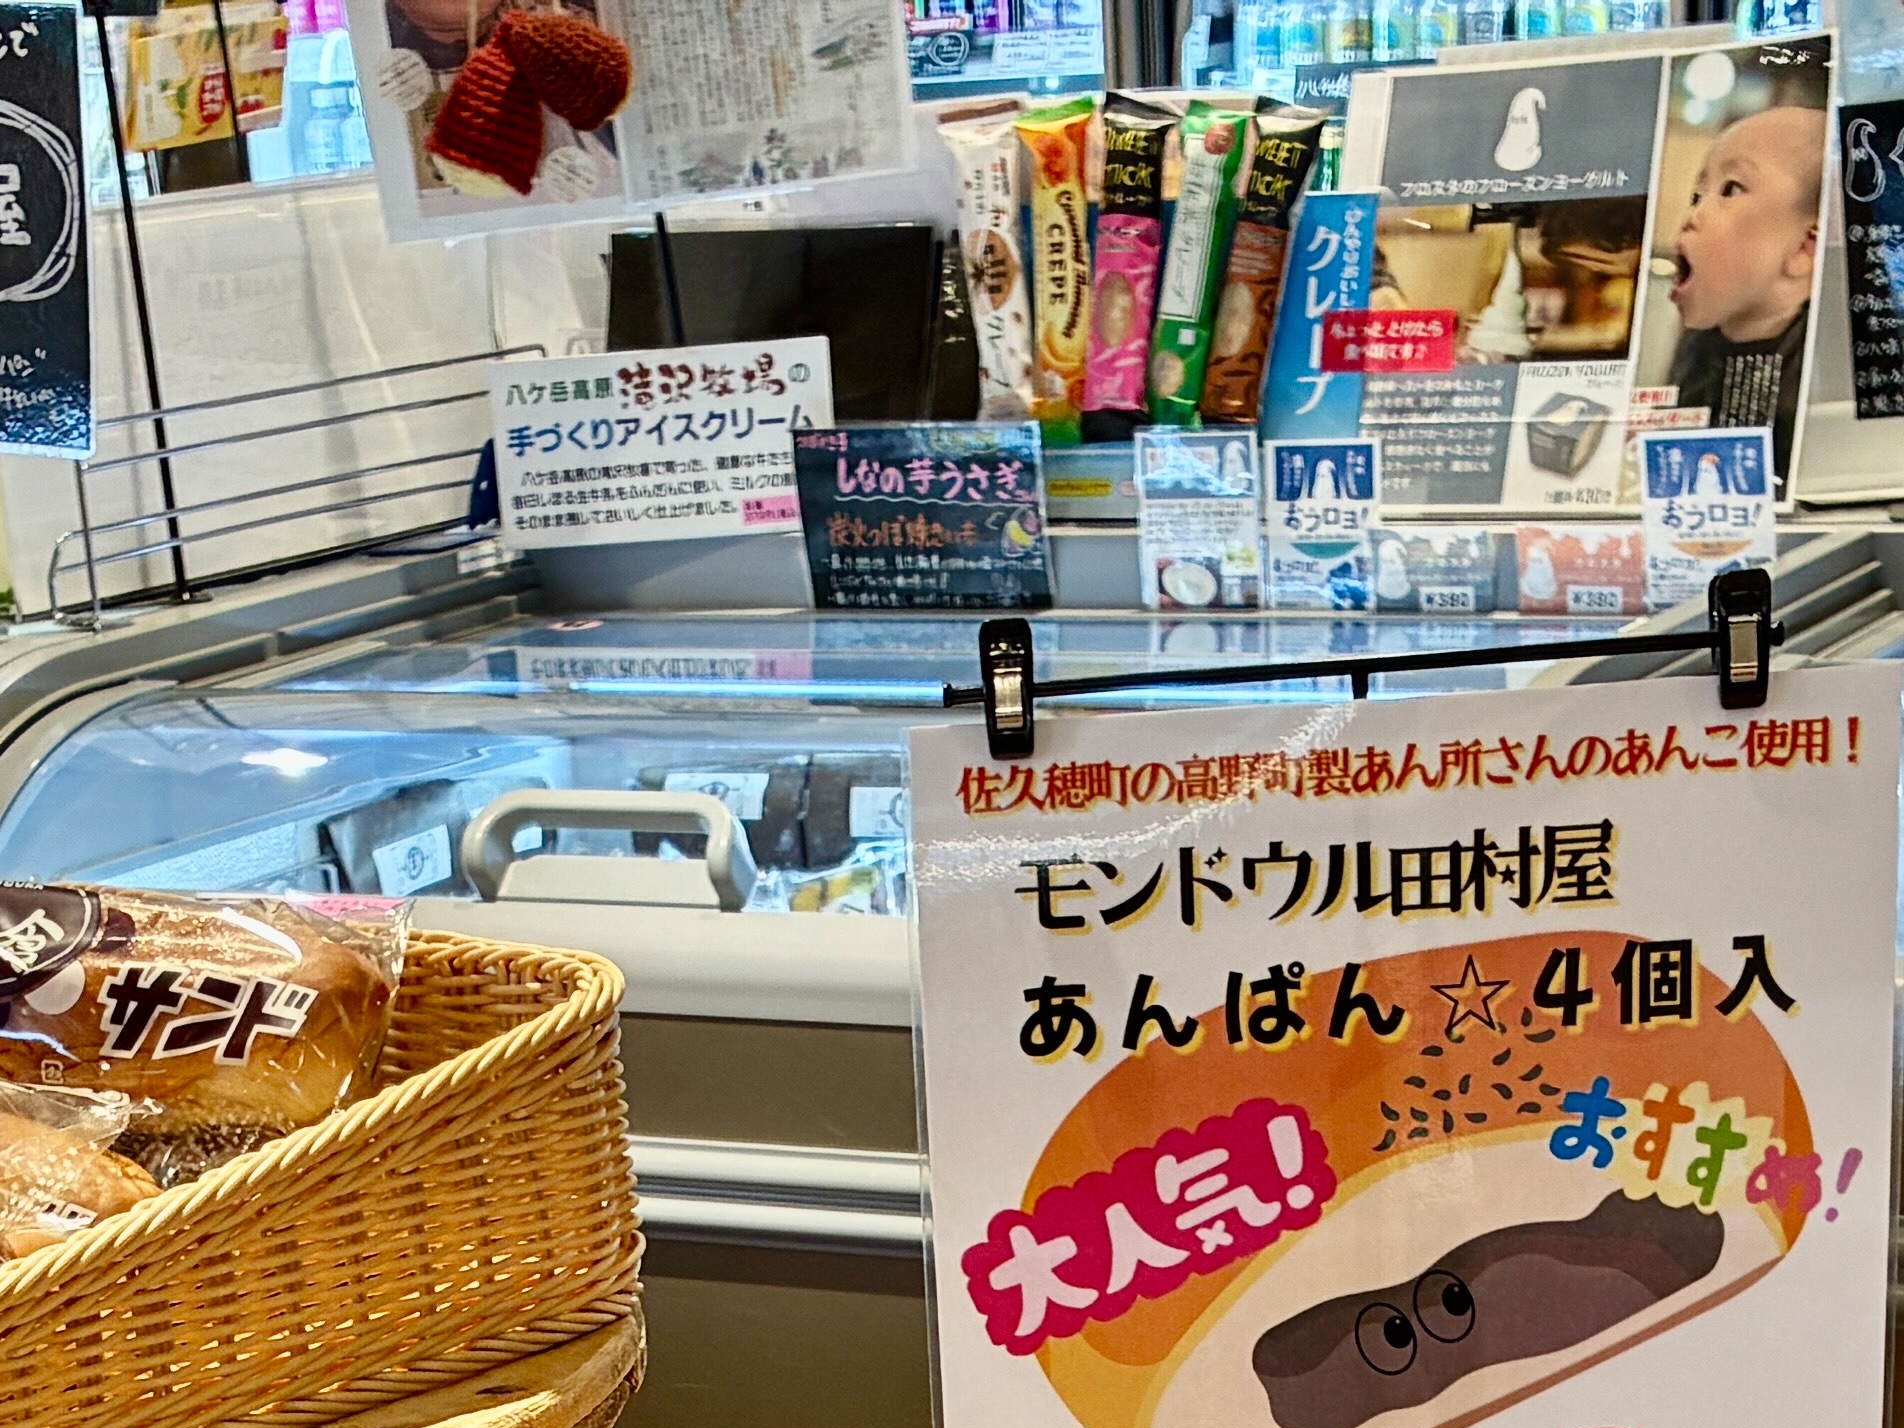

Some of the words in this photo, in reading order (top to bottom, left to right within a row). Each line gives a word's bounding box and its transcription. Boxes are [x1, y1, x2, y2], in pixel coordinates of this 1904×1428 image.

[507, 403, 815, 458] 手づくりアイスクリーム
[1014, 817, 1616, 932] モンドウル田村屋
[96, 961, 320, 1067] サンド
[1550, 1077, 1864, 1223] おすすめ!
[989, 1115, 1310, 1337] 大人気!
